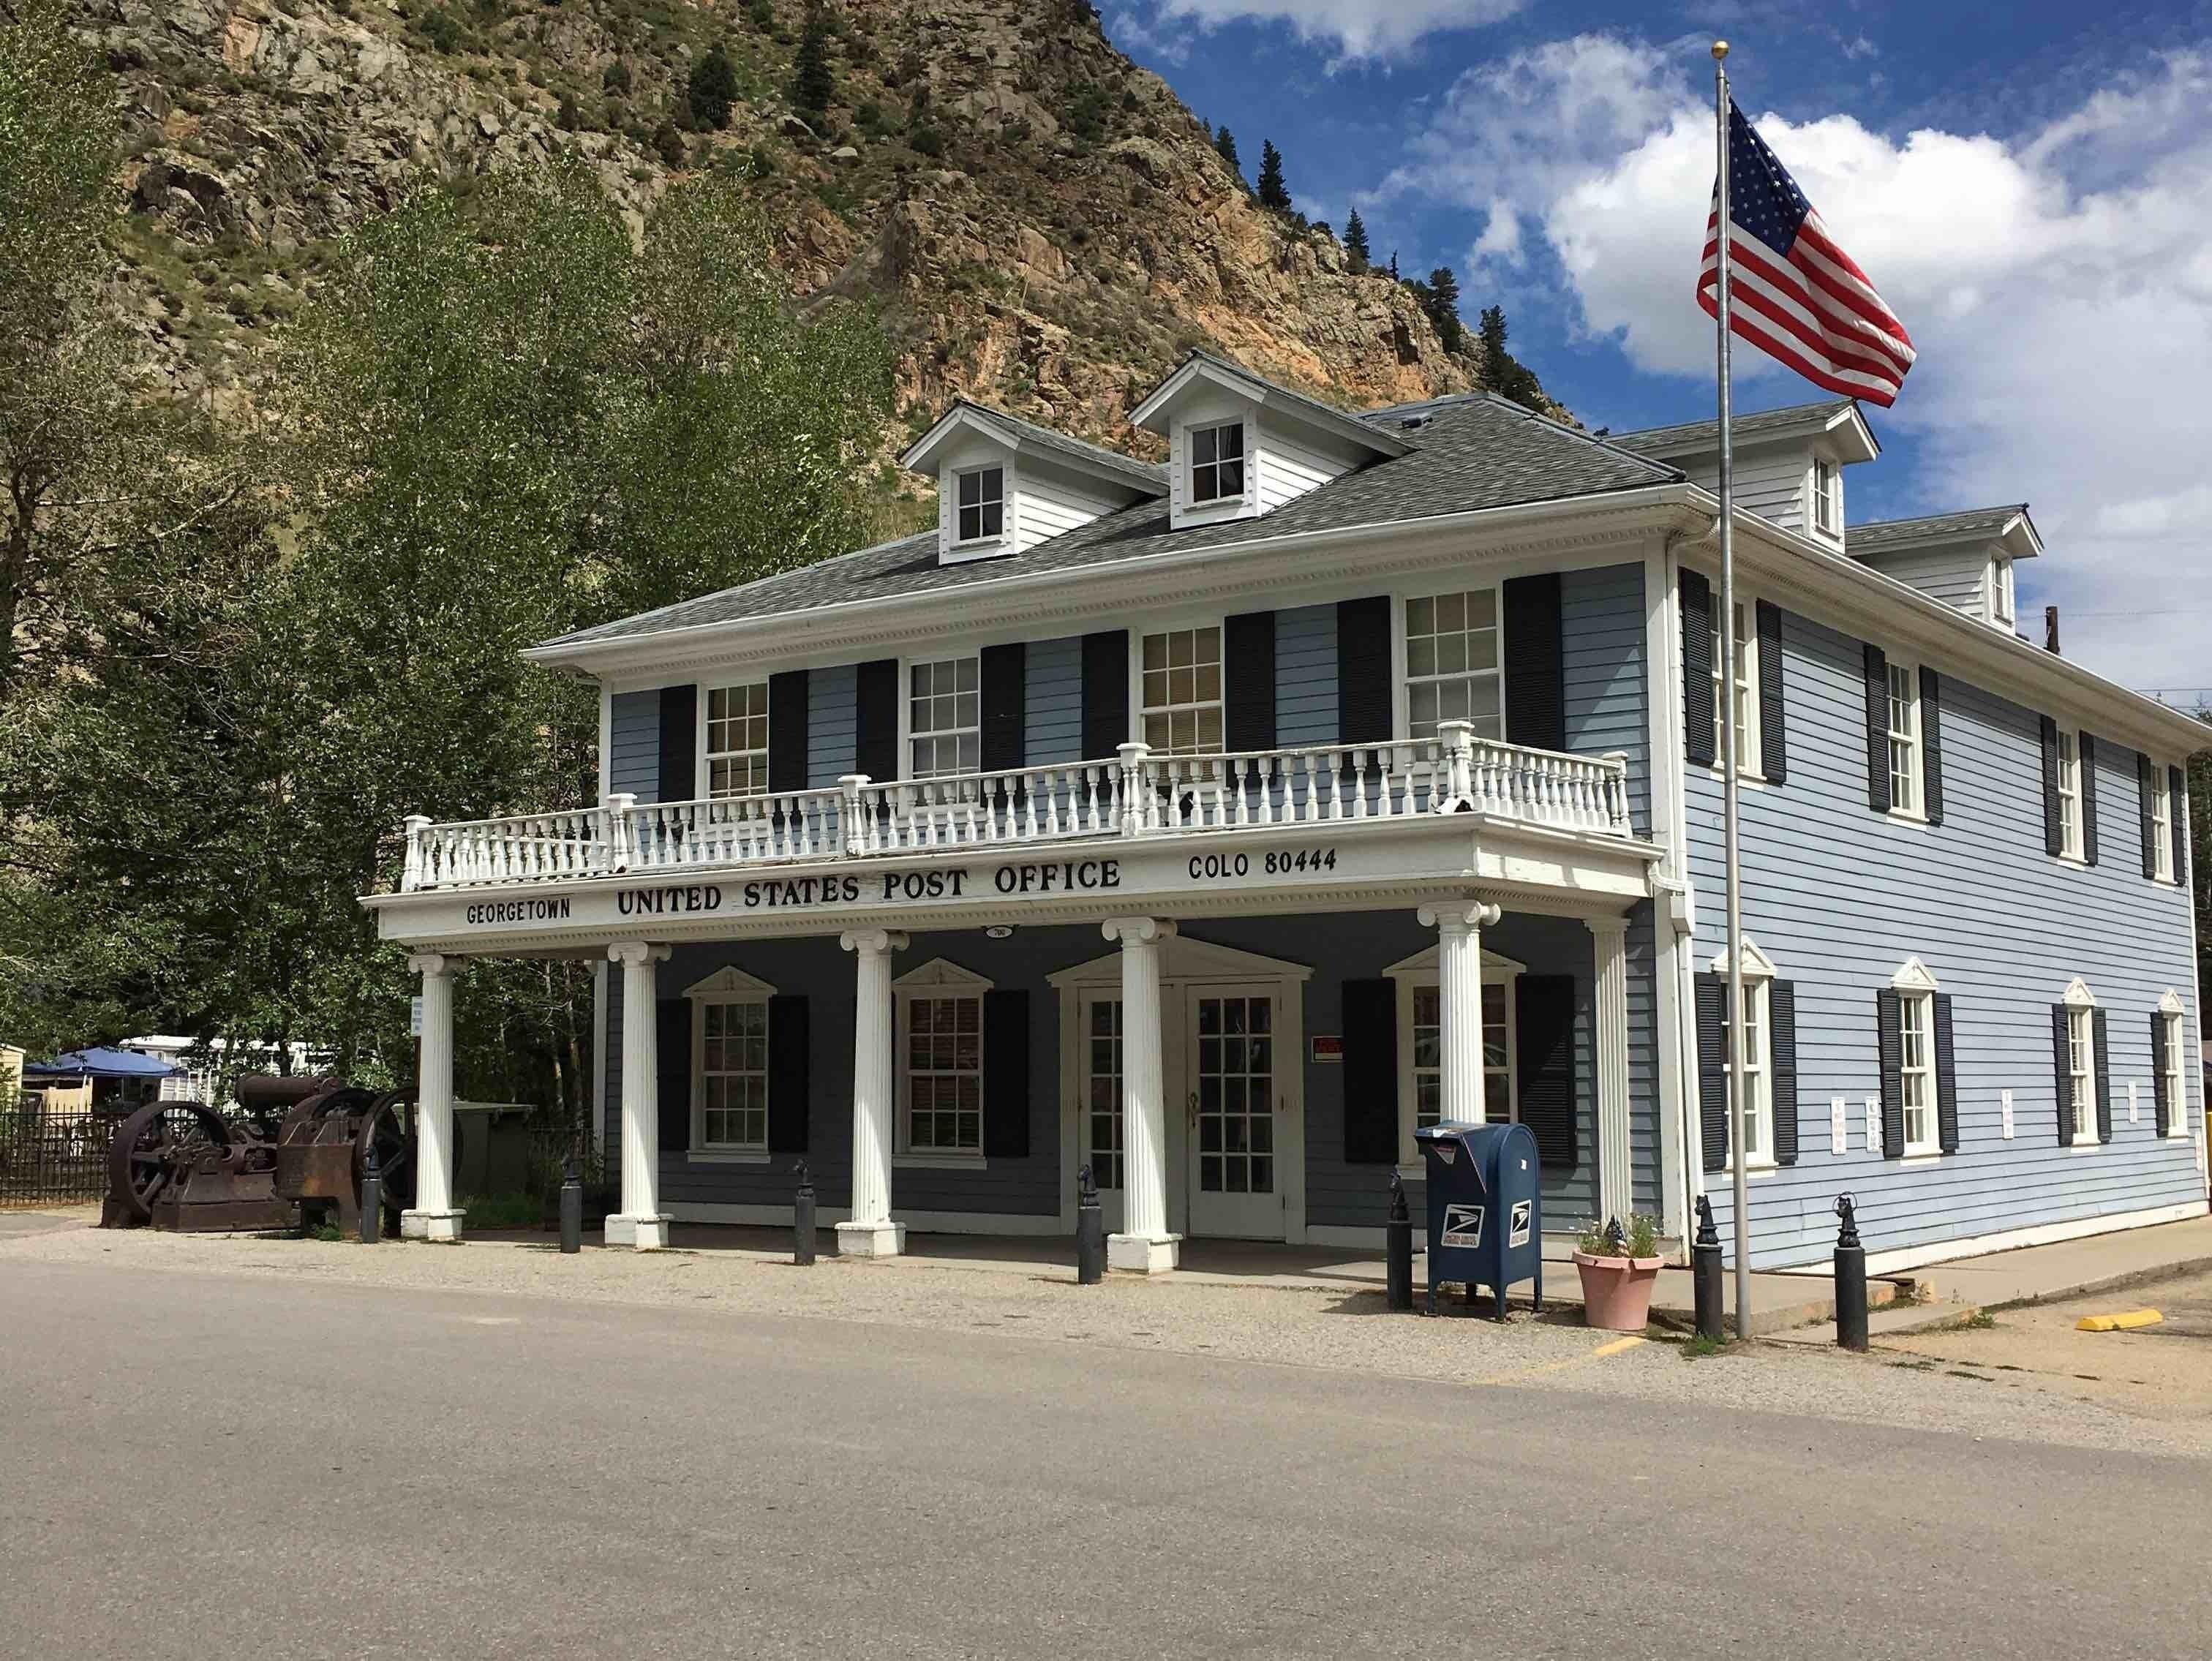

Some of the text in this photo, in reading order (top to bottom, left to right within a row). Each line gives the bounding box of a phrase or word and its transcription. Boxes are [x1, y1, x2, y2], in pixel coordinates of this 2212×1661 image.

[467, 848, 1336, 924] GEORGETOWN UNITED STATES POST OFFICE COLO 80444
